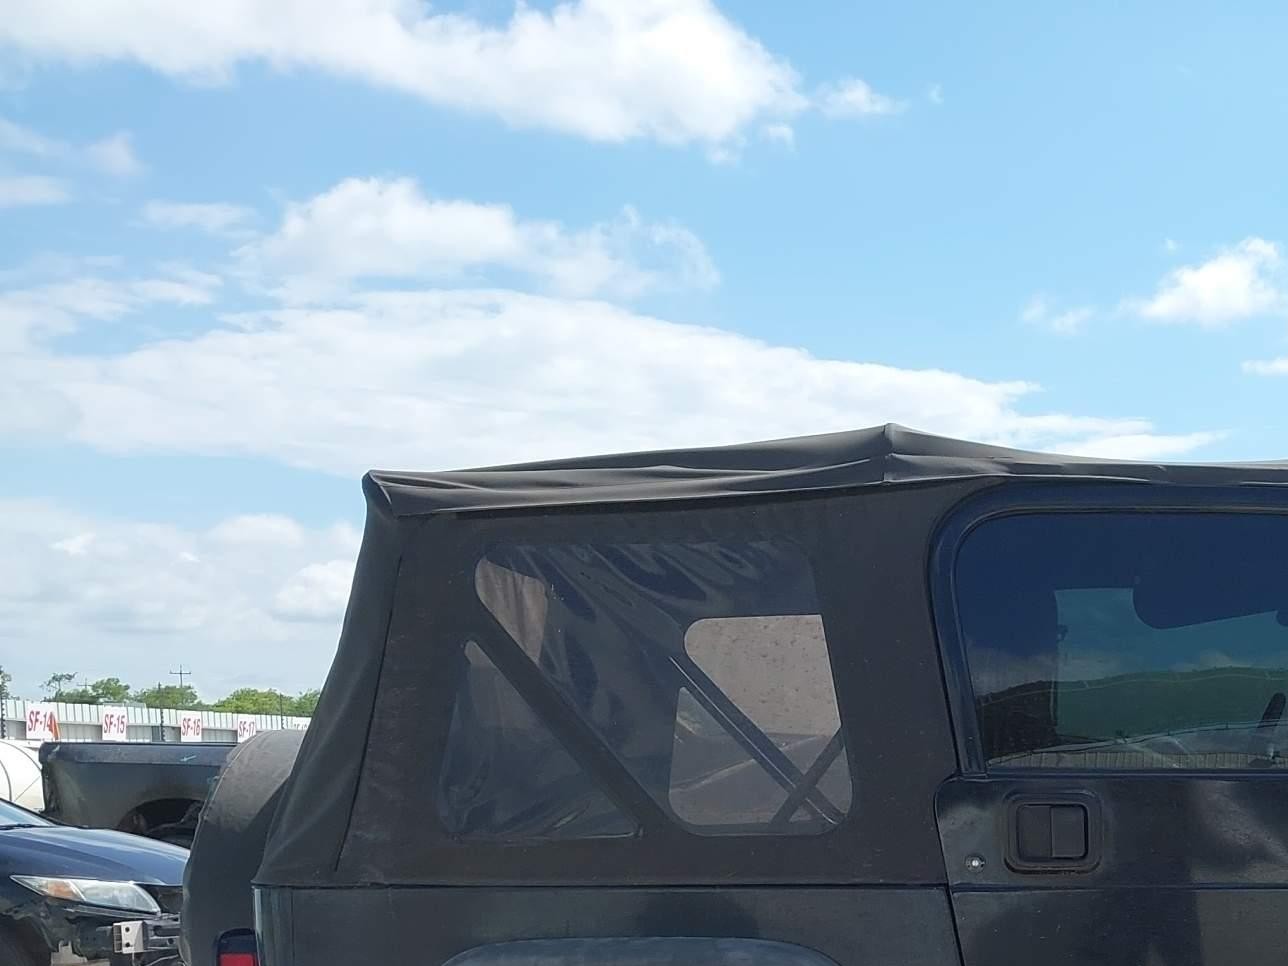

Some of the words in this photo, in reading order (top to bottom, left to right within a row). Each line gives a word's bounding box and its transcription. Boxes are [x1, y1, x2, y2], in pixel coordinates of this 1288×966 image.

[103, 714, 125, 734] SF-15
[181, 718, 201, 737] SF-16
[238, 720, 256, 737] SF-17
